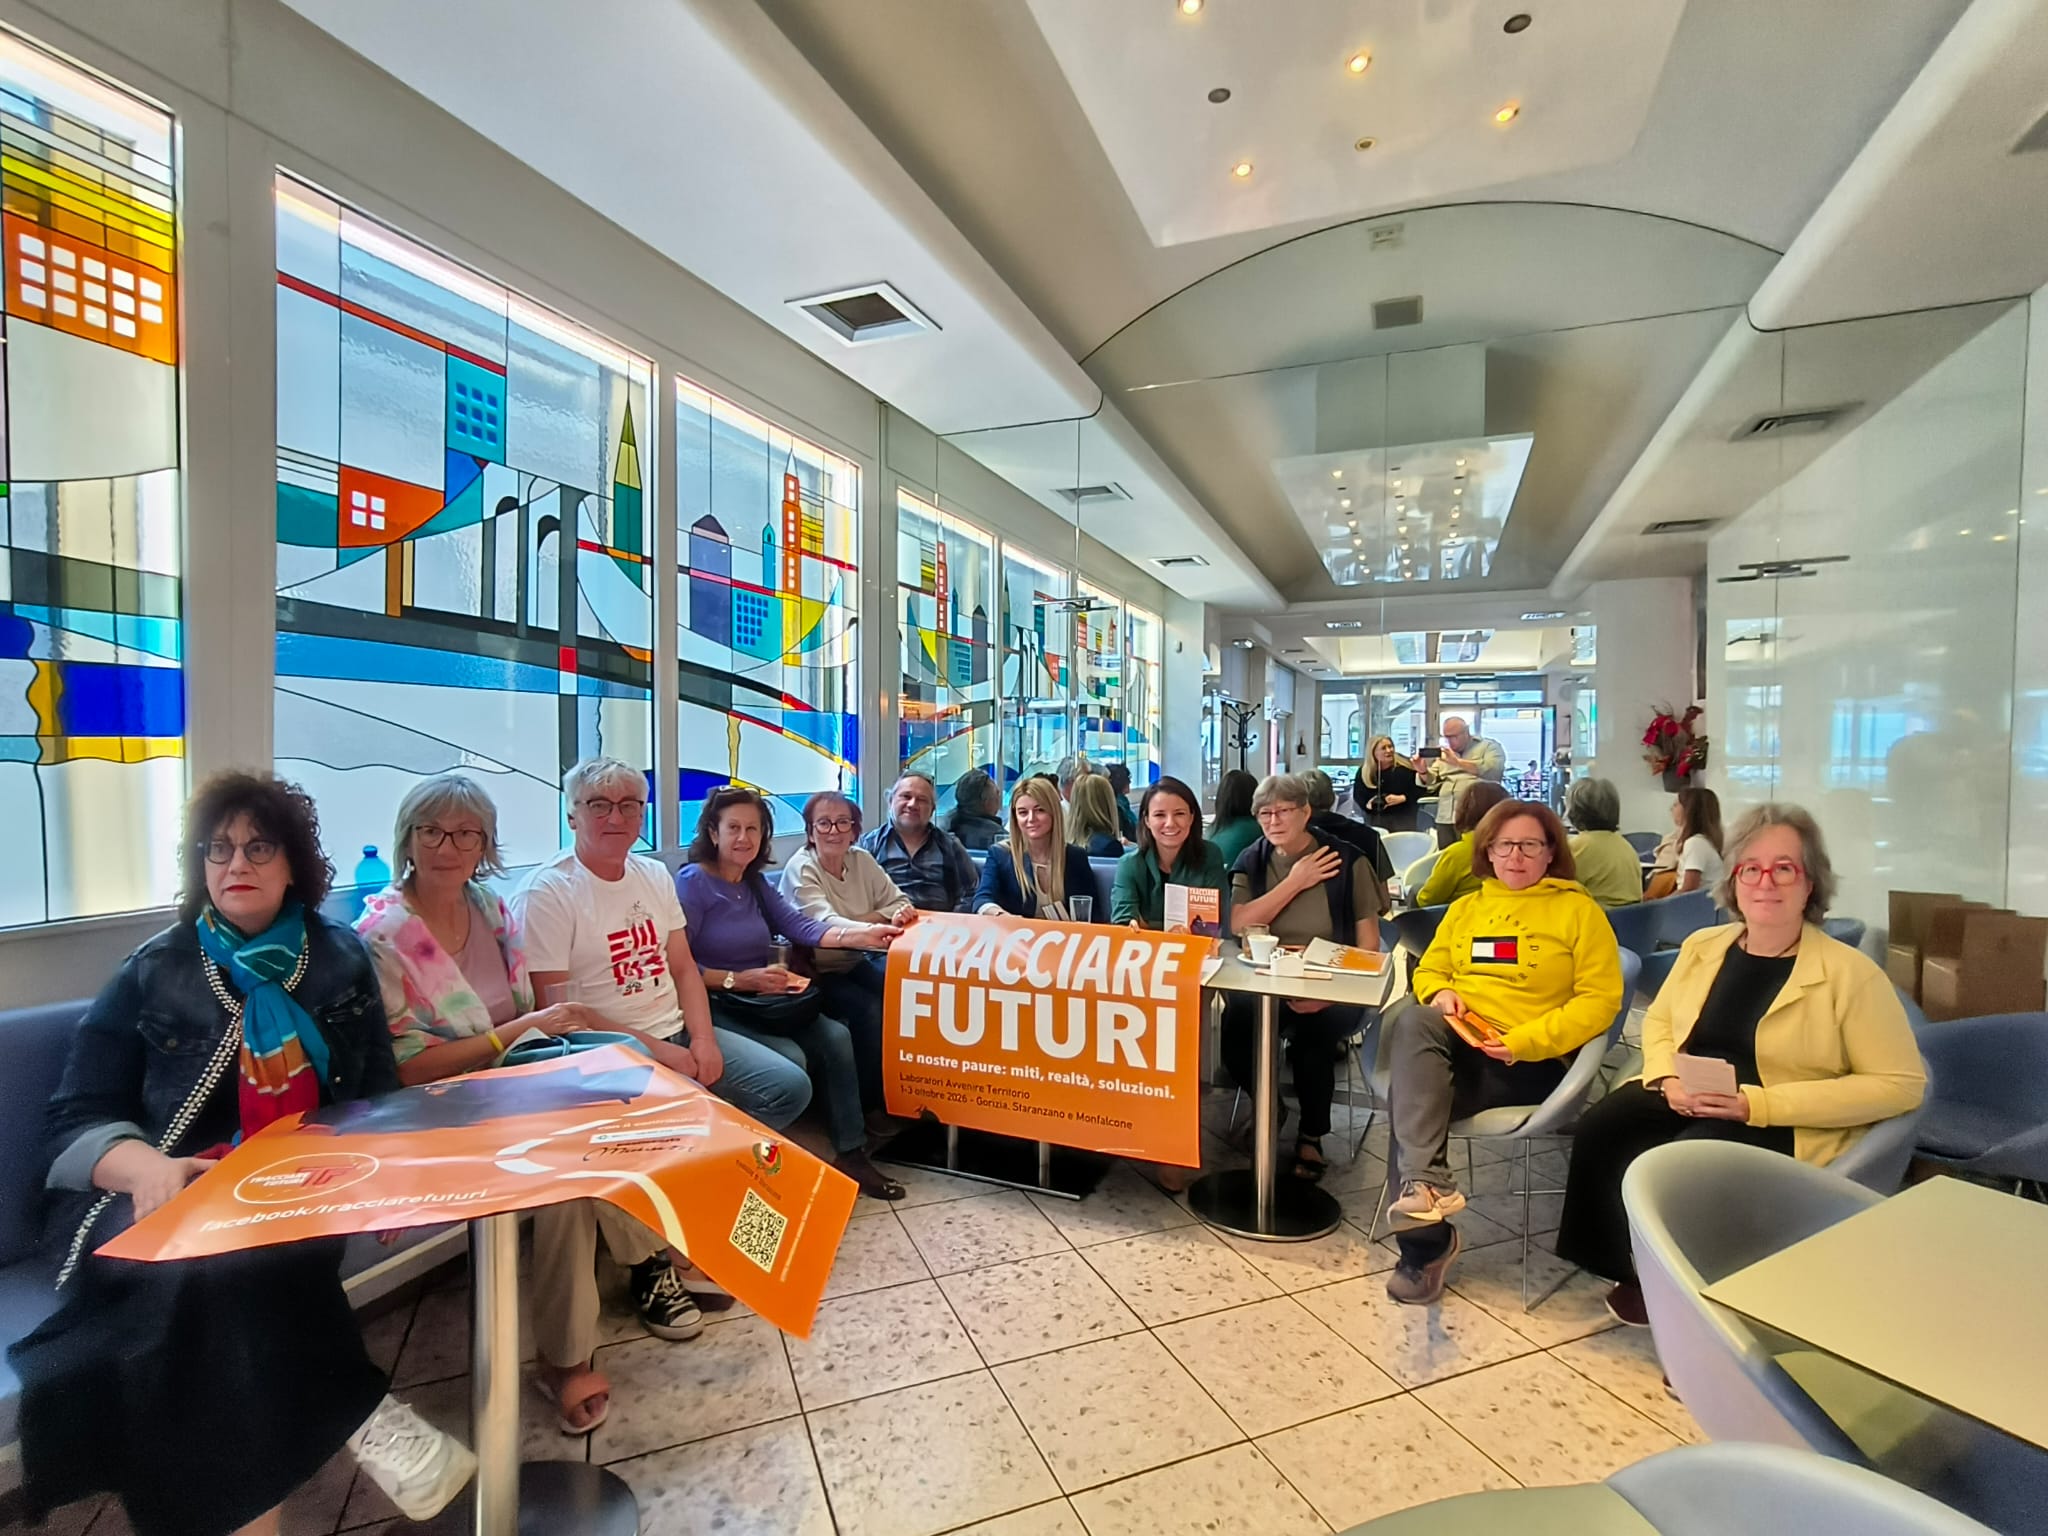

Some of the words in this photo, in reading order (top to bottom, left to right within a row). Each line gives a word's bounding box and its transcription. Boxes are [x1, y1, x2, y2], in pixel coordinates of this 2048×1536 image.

[909, 921, 1186, 1001] TRACCIARE
[899, 978, 1176, 1073] FUTURI
[899, 1049, 914, 1062] Le
[916, 1053, 959, 1069] nostre
[961, 1060, 1007, 1075] paure:
[1010, 1065, 1044, 1081] miti,
[1047, 1071, 1095, 1089] realtà,
[1098, 1078, 1176, 1099] soluzioni.
[899, 1072, 944, 1087] Laboratori
[945, 1079, 985, 1093] Avvenire
[986, 1084, 1031, 1100] Territorio
[900, 1085, 913, 1095] 1-3
[914, 1086, 945, 1100] ottobre
[1012, 1102, 1065, 1119] Staranzano
[1067, 1112, 1074, 1120] e
[1075, 1111, 1134, 1130] Monfalcone
[199, 1188, 489, 1233] facebook/tracciarefuturi
